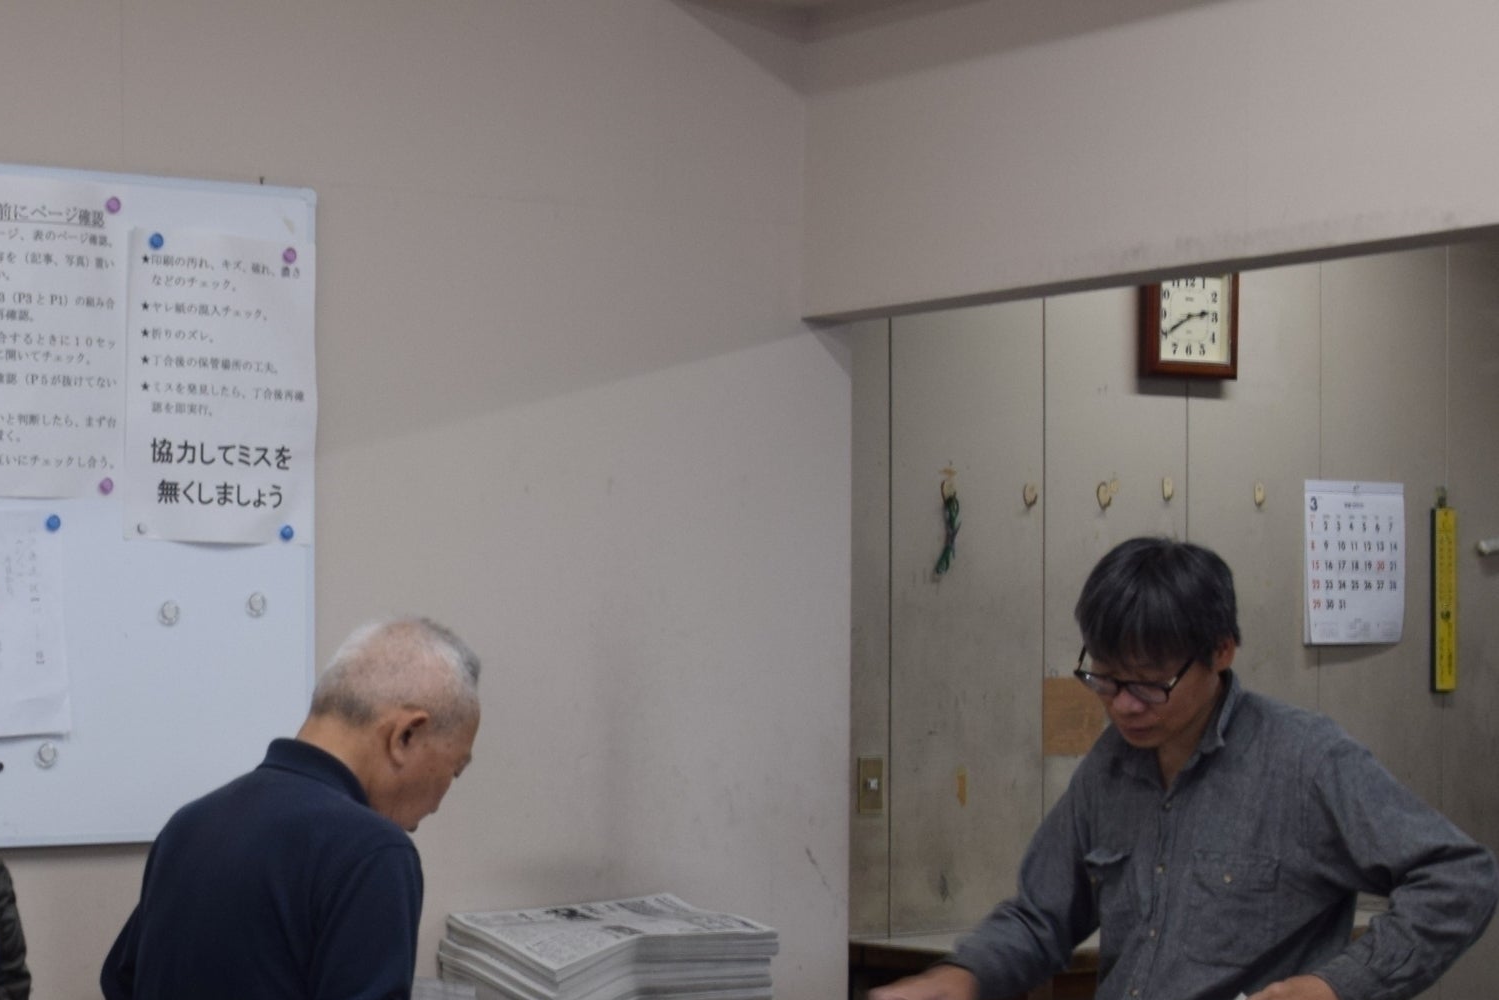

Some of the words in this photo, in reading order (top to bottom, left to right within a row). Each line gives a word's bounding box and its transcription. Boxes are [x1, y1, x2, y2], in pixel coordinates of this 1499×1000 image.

[150, 436, 293, 471] 協力してミスを
[157, 478, 284, 509] 無くしましょう
[1310, 496, 1318, 512] 3
